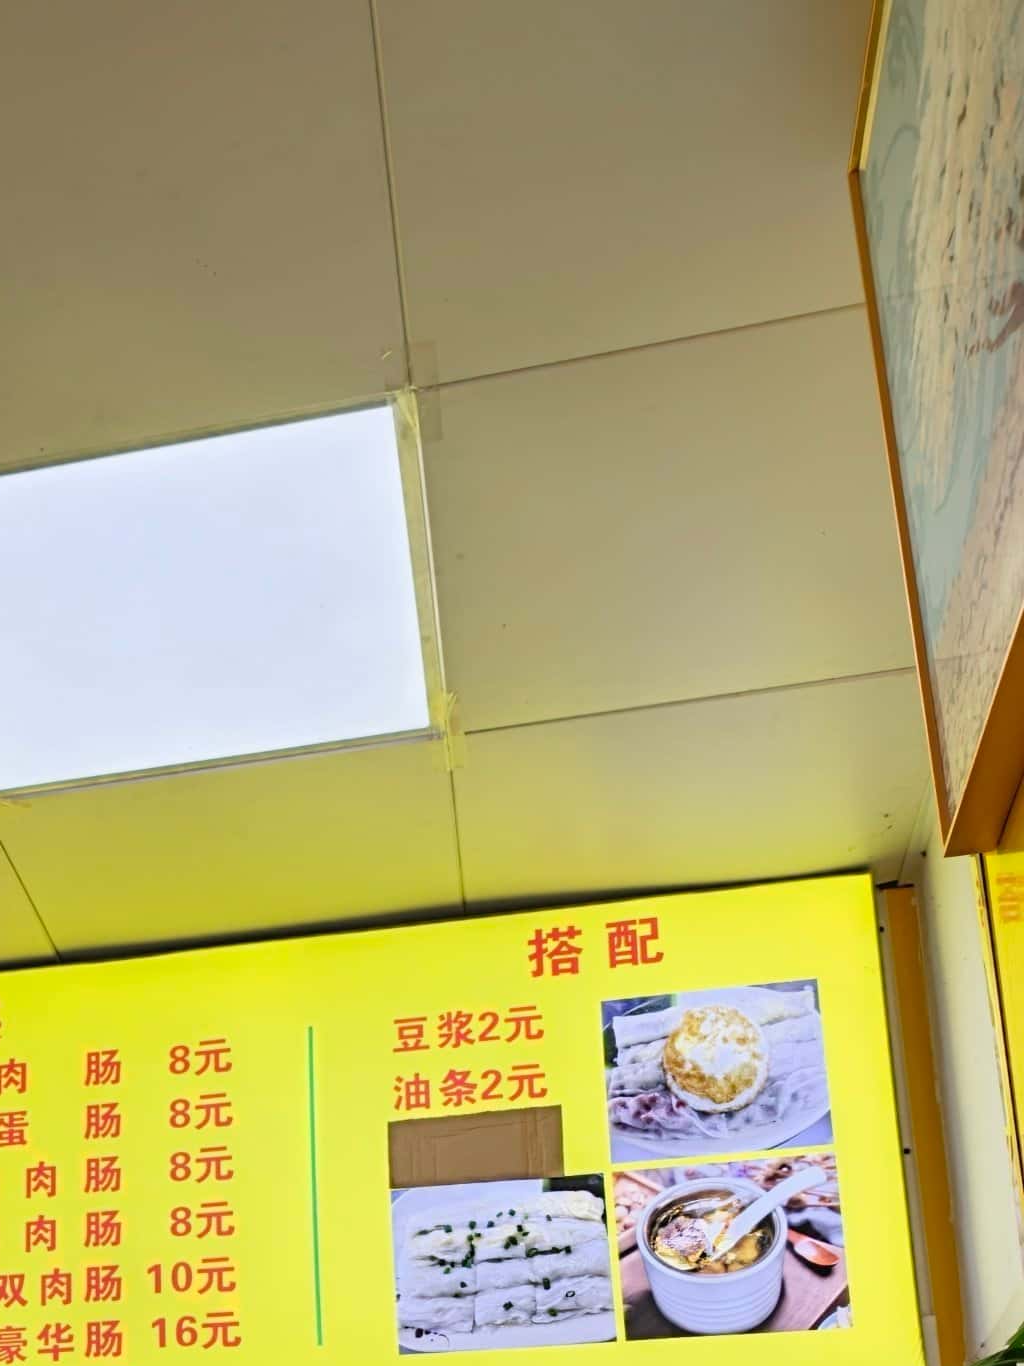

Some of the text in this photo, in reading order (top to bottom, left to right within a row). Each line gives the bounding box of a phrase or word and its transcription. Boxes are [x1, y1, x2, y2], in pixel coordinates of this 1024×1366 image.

[527, 917, 664, 978] 搭配
[394, 1005, 544, 1053] 豆浆2元
[169, 1039, 232, 1075] 8元
[393, 1063, 547, 1110] 油条2元
[169, 1093, 233, 1129] 8元
[169, 1146, 233, 1182] 8元
[170, 1201, 235, 1238] 8元
[147, 1256, 236, 1295] 10元
[152, 1310, 241, 1348] 16元
